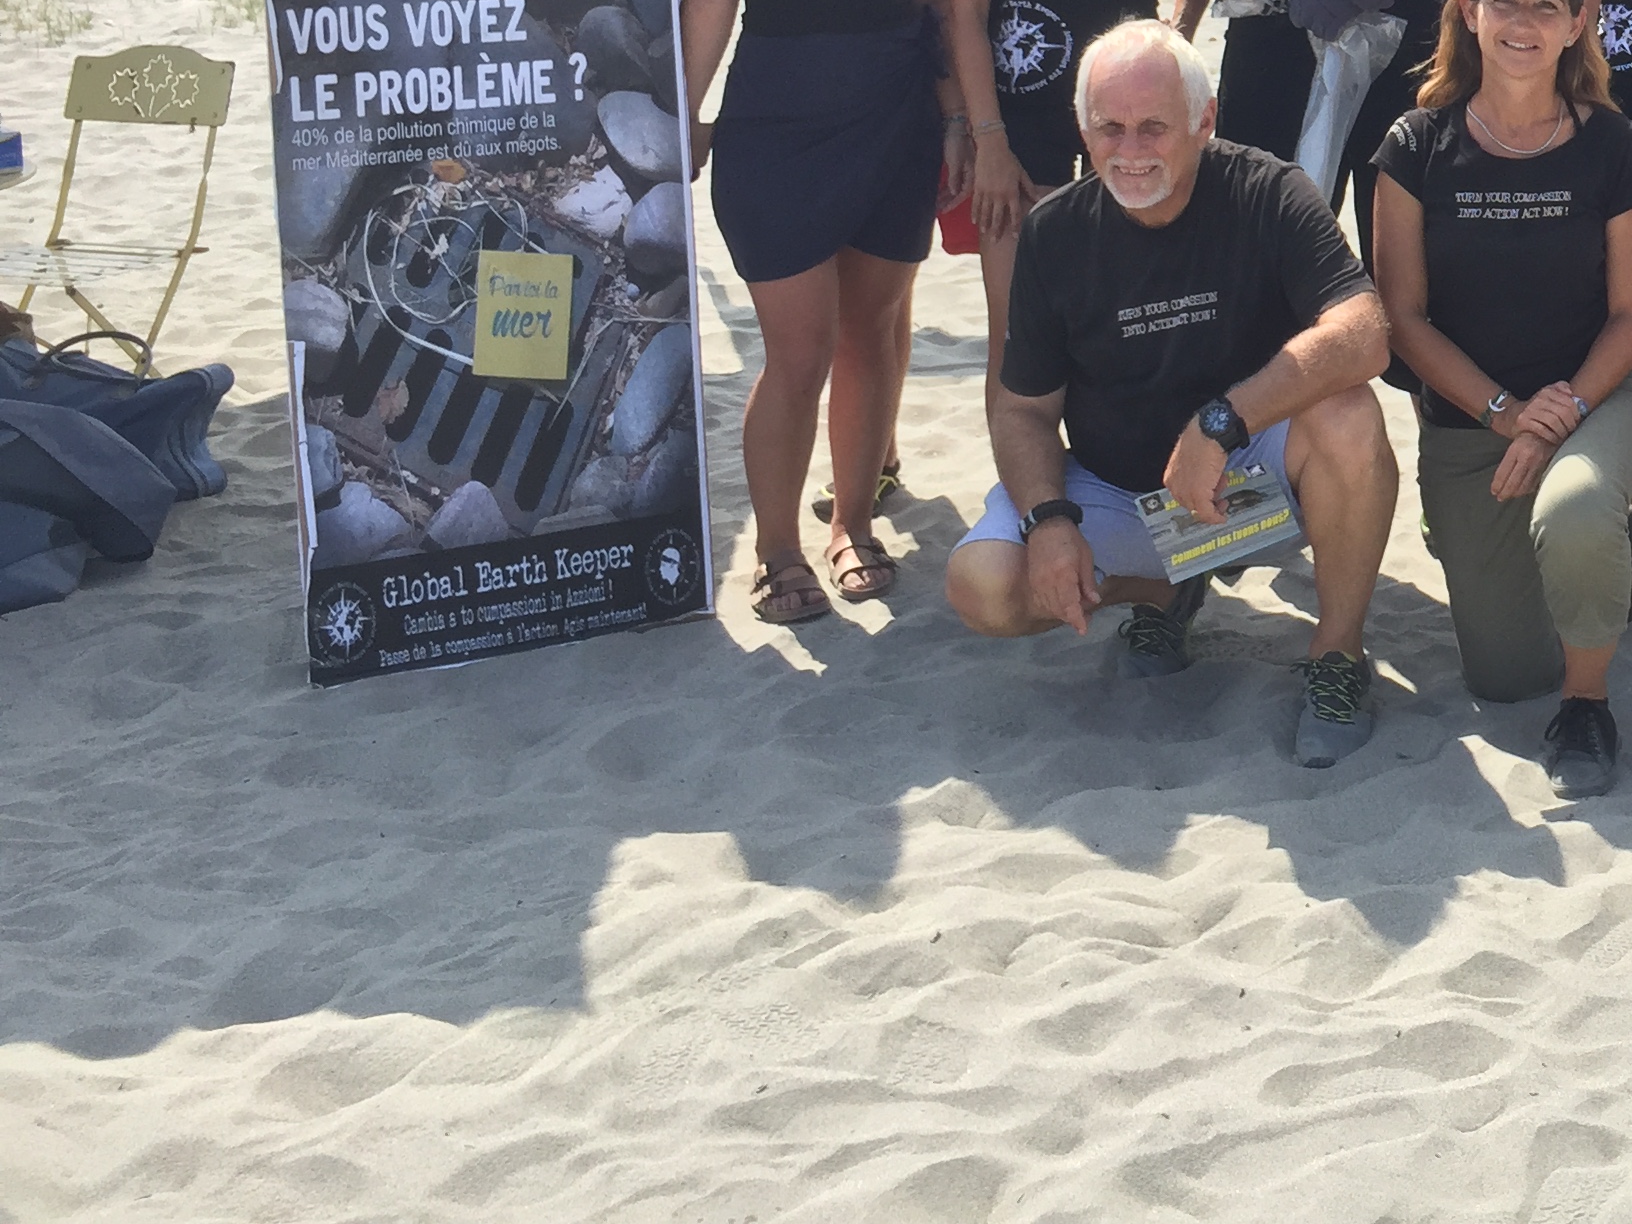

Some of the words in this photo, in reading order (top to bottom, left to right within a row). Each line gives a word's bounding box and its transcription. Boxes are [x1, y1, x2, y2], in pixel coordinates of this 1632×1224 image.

[286, 4, 390, 55] VOUS
[291, 74, 342, 122] LE
[355, 52, 557, 117] PROBLÈME
[568, 52, 588, 102] ?
[291, 128, 329, 148] 40%
[334, 126, 355, 145] de
[358, 125, 373, 143] la
[377, 119, 443, 145] pollution
[446, 117, 516, 137] chimique
[519, 114, 539, 131] de
[542, 111, 556, 128] la
[291, 154, 322, 171] mer
[325, 144, 423, 170] Méditerranée
[426, 145, 450, 161] est
[453, 141, 472, 159] dû
[475, 141, 501, 156] aux
[505, 135, 562, 156] mégots.
[1455, 192, 1483, 203] TURN
[1485, 192, 1512, 203] YOUR
[1511, 191, 1572, 204] COMPASSION
[1457, 208, 1482, 218] INTO
[1482, 208, 1519, 219] ACTION
[1521, 207, 1541, 219] ACT
[489, 273, 521, 298] Par
[545, 279, 559, 299] la
[491, 308, 553, 339] mer
[1143, 301, 1171, 317] YOUR
[1171, 538, 1216, 566] Comment
[1217, 532, 1232, 547] les
[1233, 522, 1260, 542] tuons
[1260, 507, 1290, 530] nous?
[382, 565, 469, 609] Global
[474, 554, 549, 593] Earth
[555, 543, 634, 581] Keeper
[403, 609, 446, 636] Cambia
[448, 612, 457, 627] a
[460, 606, 474, 626] to
[476, 592, 548, 625] cumpassioni
[551, 590, 562, 612] in
[378, 649, 411, 667] Passe
[412, 642, 427, 661] de
[429, 640, 442, 658] la
[445, 632, 505, 656] compassion
[506, 627, 513, 645] à
[563, 617, 585, 637] Agis
